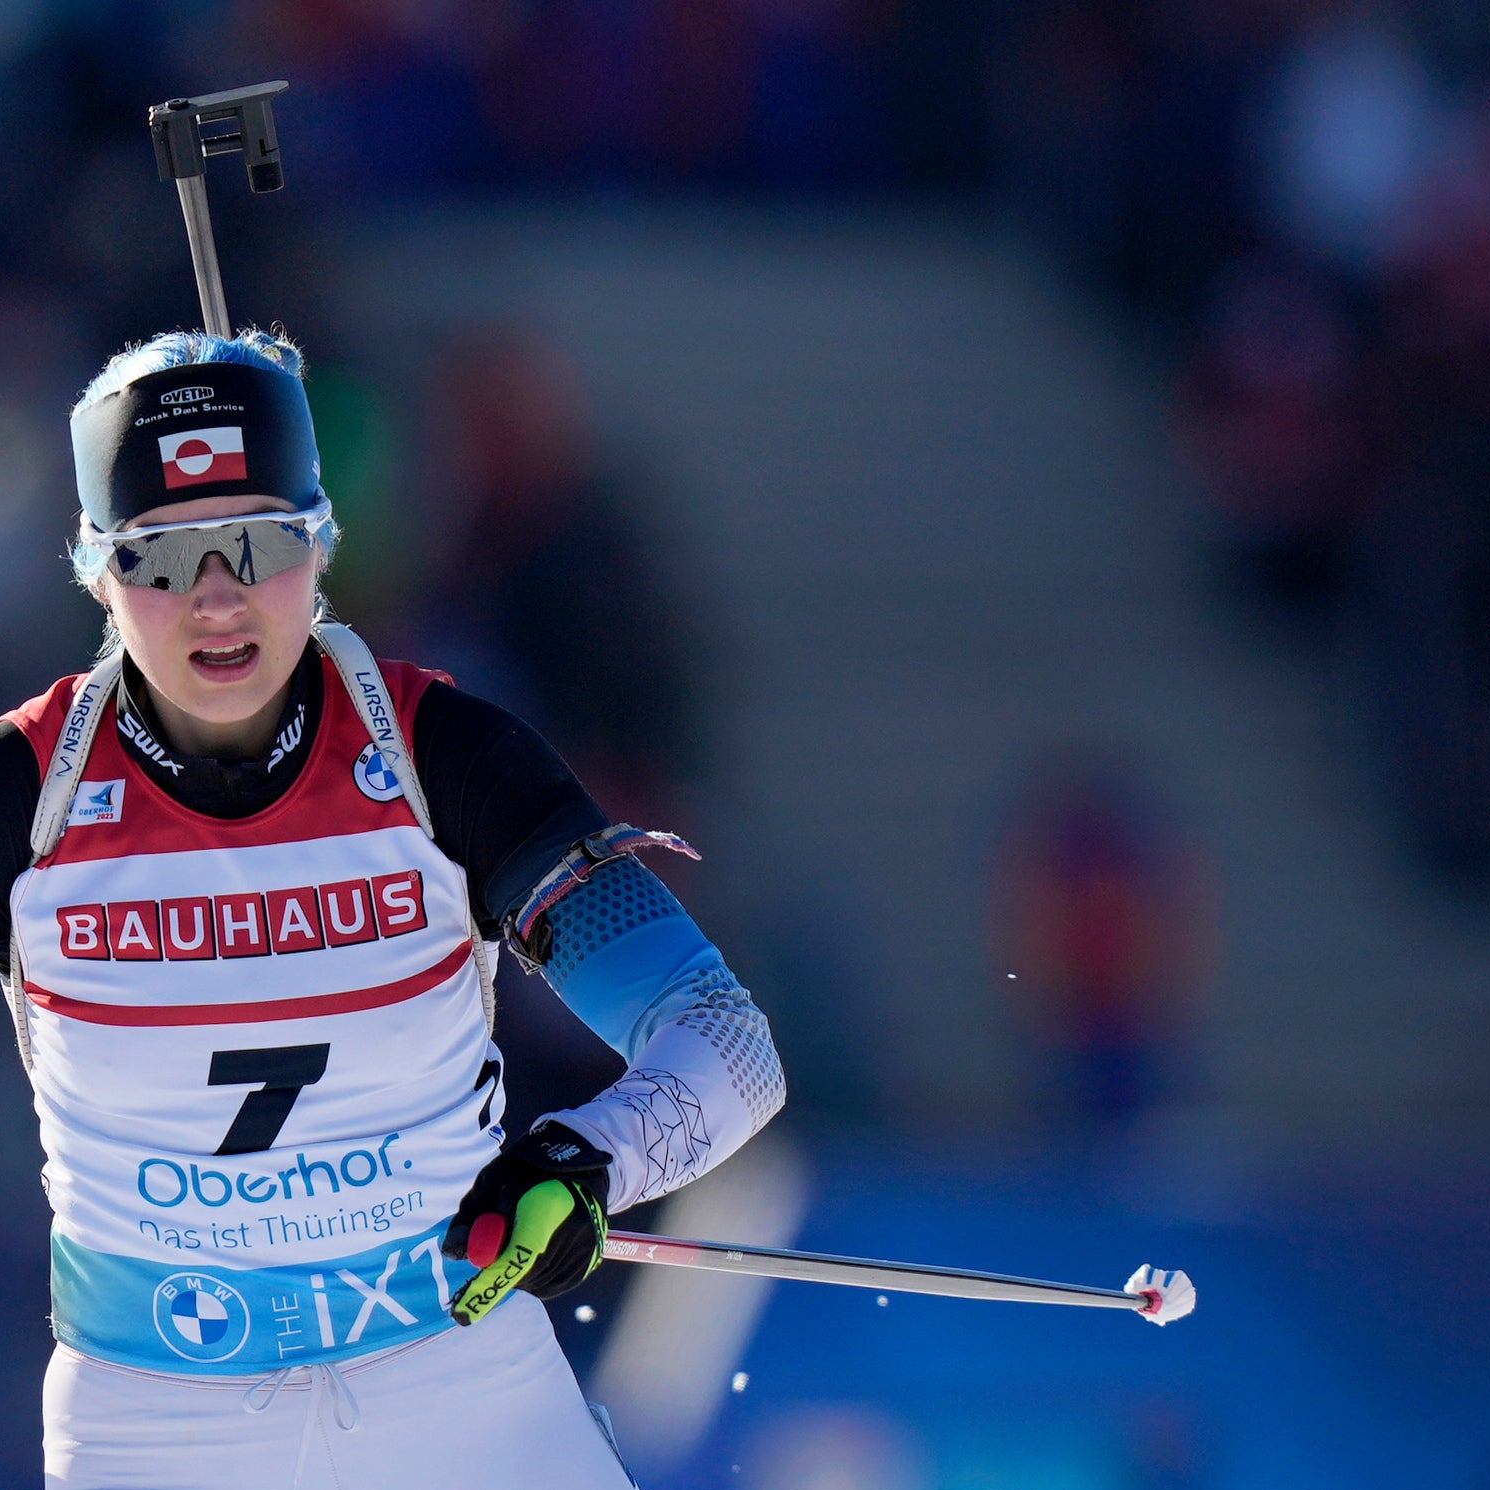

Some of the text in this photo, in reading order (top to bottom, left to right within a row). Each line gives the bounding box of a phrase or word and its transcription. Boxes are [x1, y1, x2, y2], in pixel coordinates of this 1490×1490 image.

[202, 403, 244, 412] Service
[62, 683, 100, 753] LARSEN
[355, 671, 394, 742] LARSEN
[78, 805, 115, 816] OBERHOF
[65, 880, 417, 950] BAUHAUS
[207, 1043, 331, 1155] 7
[212, 1223, 252, 1248] ist
[258, 1190, 423, 1245] Thüringen
[271, 1293, 305, 1359] THE
[310, 1235, 452, 1348] iX1
